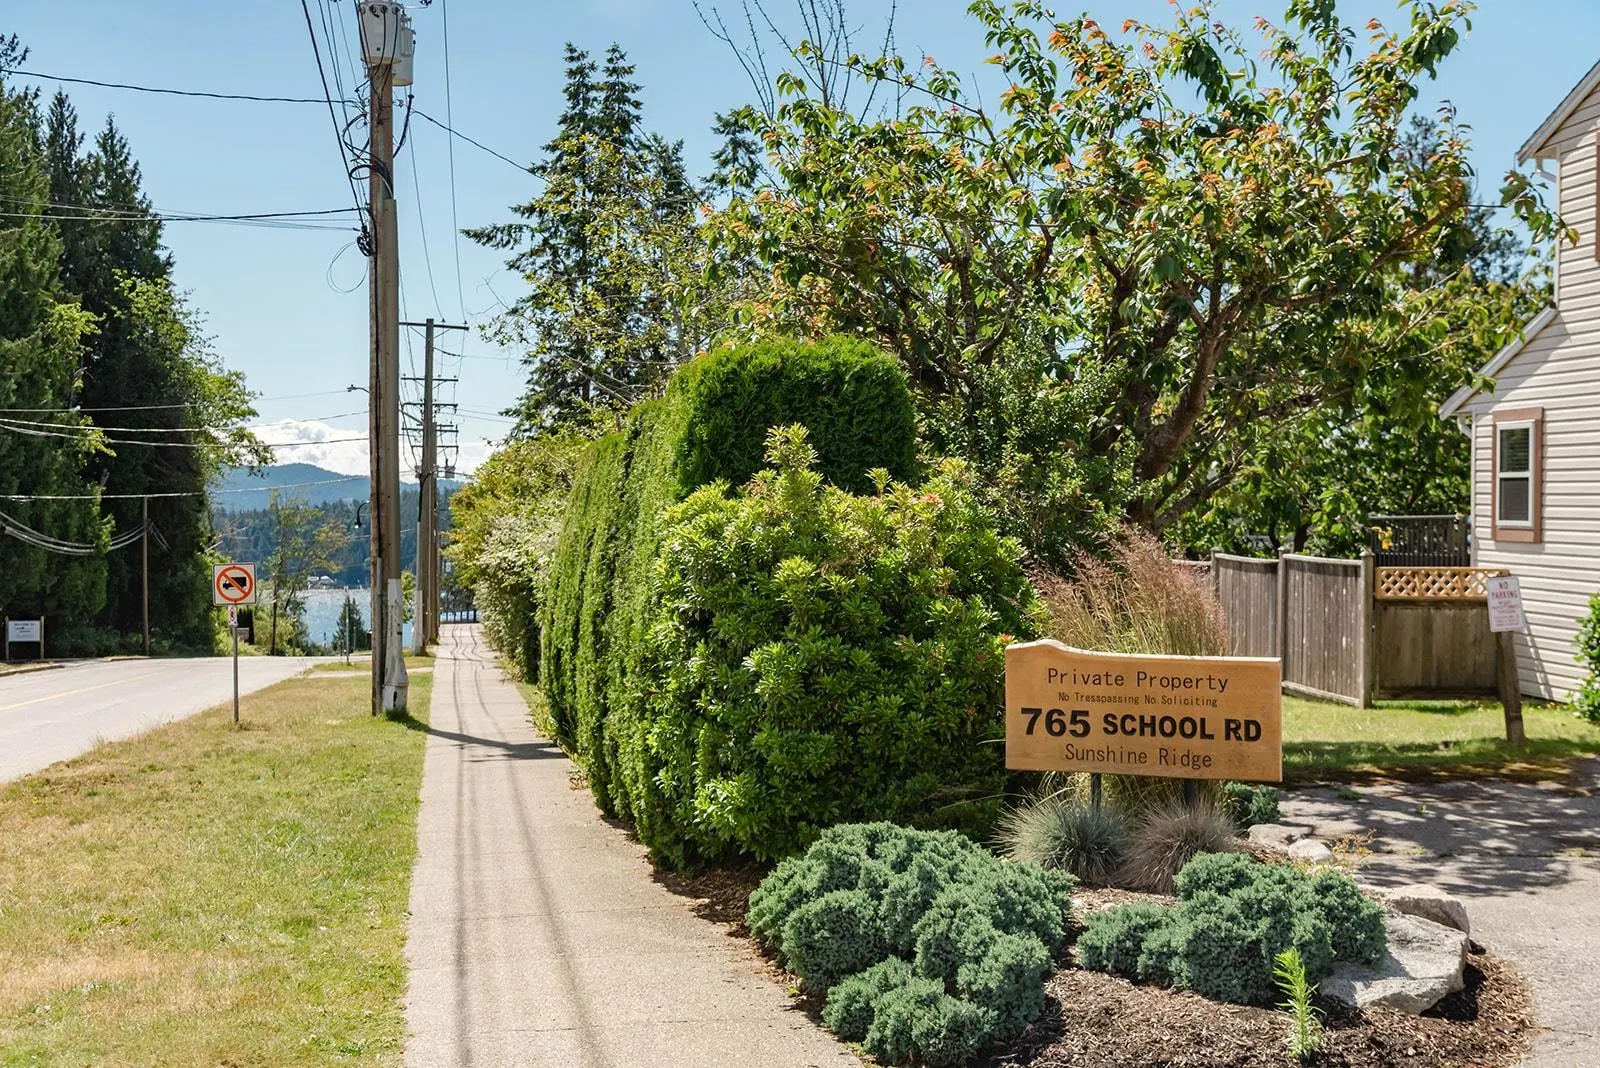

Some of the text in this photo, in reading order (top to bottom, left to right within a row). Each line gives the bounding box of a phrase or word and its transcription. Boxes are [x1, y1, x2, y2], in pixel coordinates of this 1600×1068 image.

[1491, 591, 1518, 600] PARKING
[1498, 581, 1509, 590] NO
[1048, 667, 1229, 693] Private Property
[1058, 692, 1218, 708] No Tresspassing No Soliciting
[1020, 707, 1262, 742] 765 SCHOOL RD
[1064, 743, 1212, 770] Sunshine Ridge
